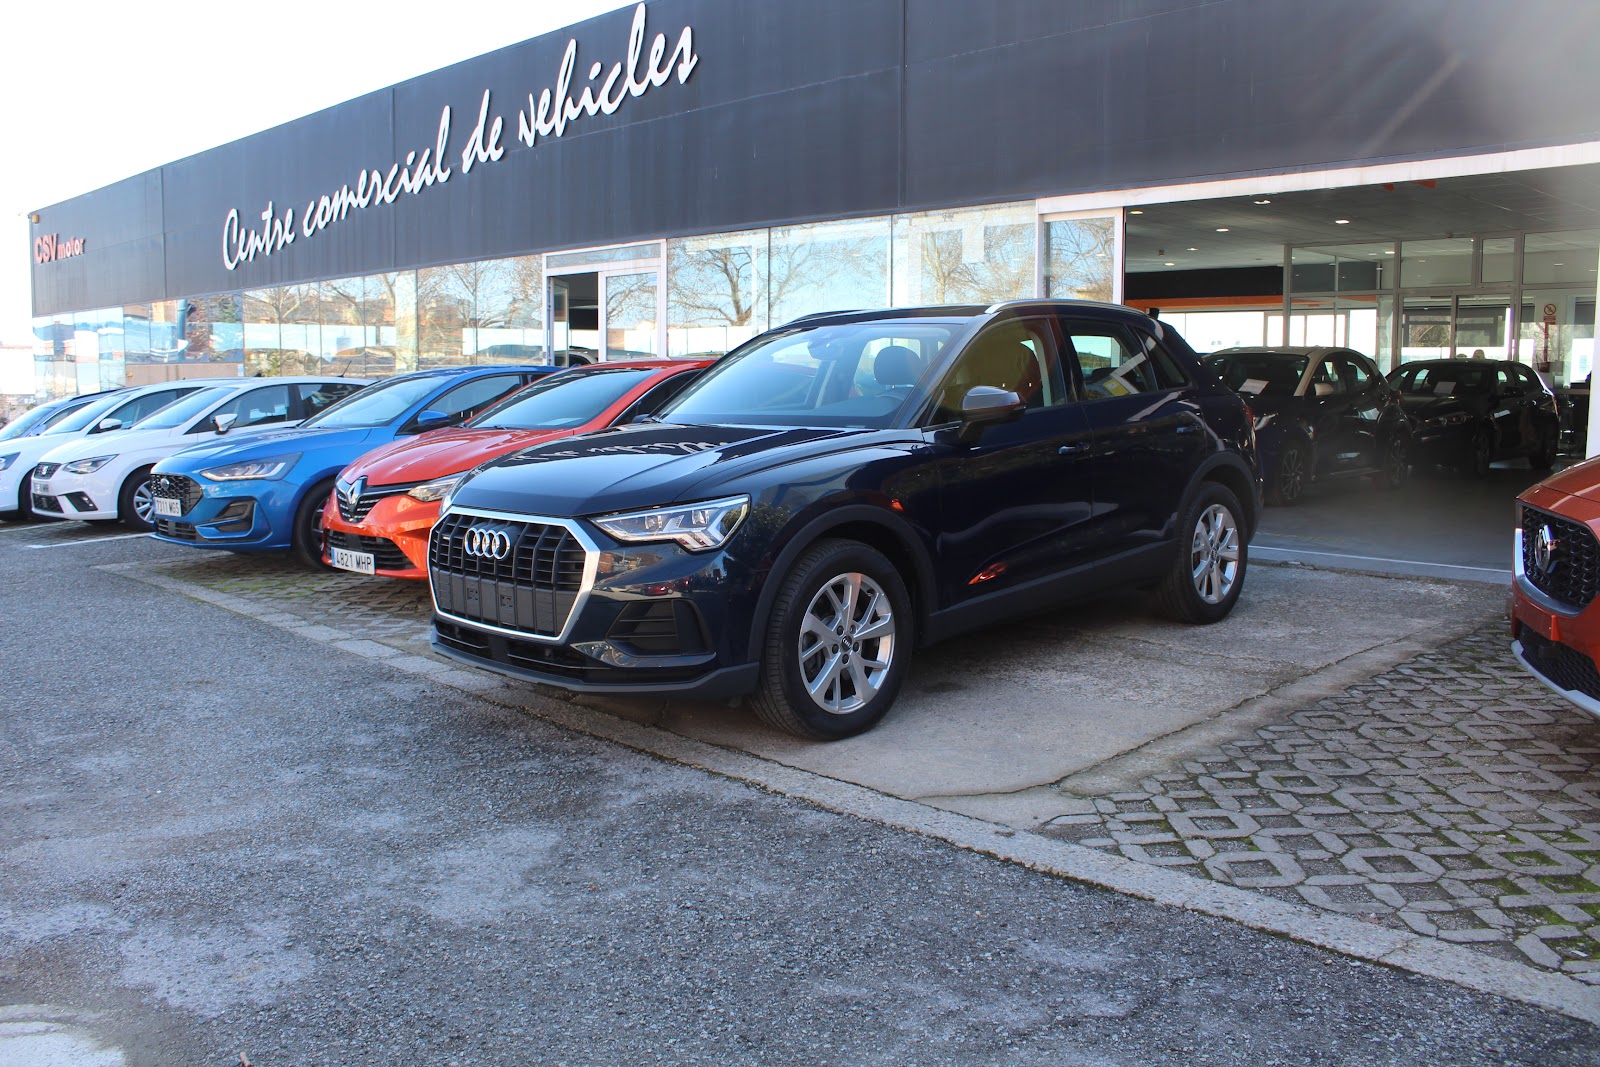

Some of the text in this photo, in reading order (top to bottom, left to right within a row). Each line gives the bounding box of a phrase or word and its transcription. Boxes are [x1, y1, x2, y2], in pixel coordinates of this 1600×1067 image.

[223, 2, 699, 271] Centre comercial de vehicles
[34, 233, 85, 264] CSV motor
[336, 551, 372, 570] 4821 MHP
